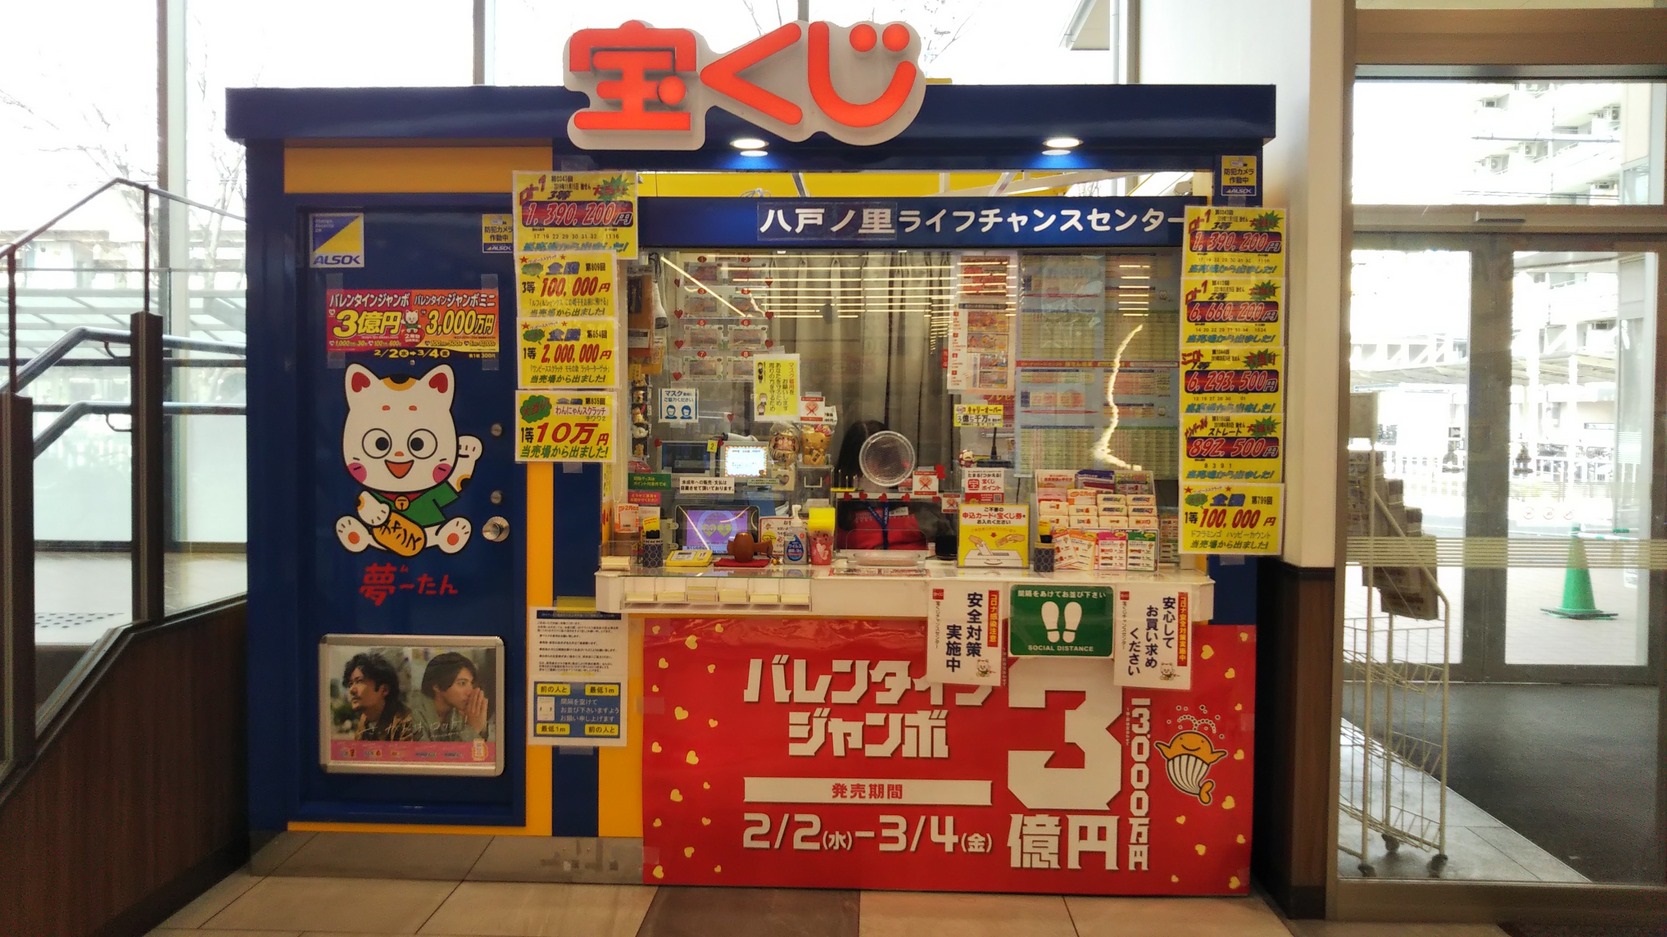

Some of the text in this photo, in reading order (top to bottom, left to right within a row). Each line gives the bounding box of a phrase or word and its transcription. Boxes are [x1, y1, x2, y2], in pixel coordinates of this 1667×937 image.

[570, 20, 916, 131] 宝くじ
[760, 208, 1184, 233] 八戸ノ里ライフチャンスセンター
[313, 255, 361, 265] ALSOK
[522, 276, 610, 297] 3等 100,000円
[329, 292, 411, 307] バレンタインジャンボ
[414, 292, 495, 307] バレンタインジャンボミニ
[333, 309, 402, 337] 3億円
[426, 309, 495, 334] 3,000万円
[530, 308, 605, 317] 当売場から出ました!
[524, 344, 612, 363] 1等 2,000,000円
[530, 375, 606, 383] 当売場から出ました!
[556, 406, 606, 415] わんにゃんスクラッチ
[536, 422, 609, 446] 10万円
[1208, 428, 1242, 436] ストレート
[521, 445, 608, 458] 当売場から出ました!
[1185, 508, 1276, 529] 1等 100,000円
[1190, 541, 1269, 549] 当売場から出ました!
[1226, 531, 1271, 539] ハッピーカウント
[1018, 590, 1106, 598] 間隔をあけてお並び下さい
[966, 592, 983, 657] 安全対策
[1162, 596, 1176, 648] 安心して
[1179, 597, 1187, 661] コロナ安全対策実施中
[1145, 605, 1158, 668] お買い求め
[946, 624, 962, 672] 実施中
[1128, 628, 1141, 676] ください
[541, 685, 567, 693] 前の人と
[788, 708, 948, 758] ジャンボ
[831, 783, 903, 800] 発売期間
[1006, 814, 1120, 871] 億円
